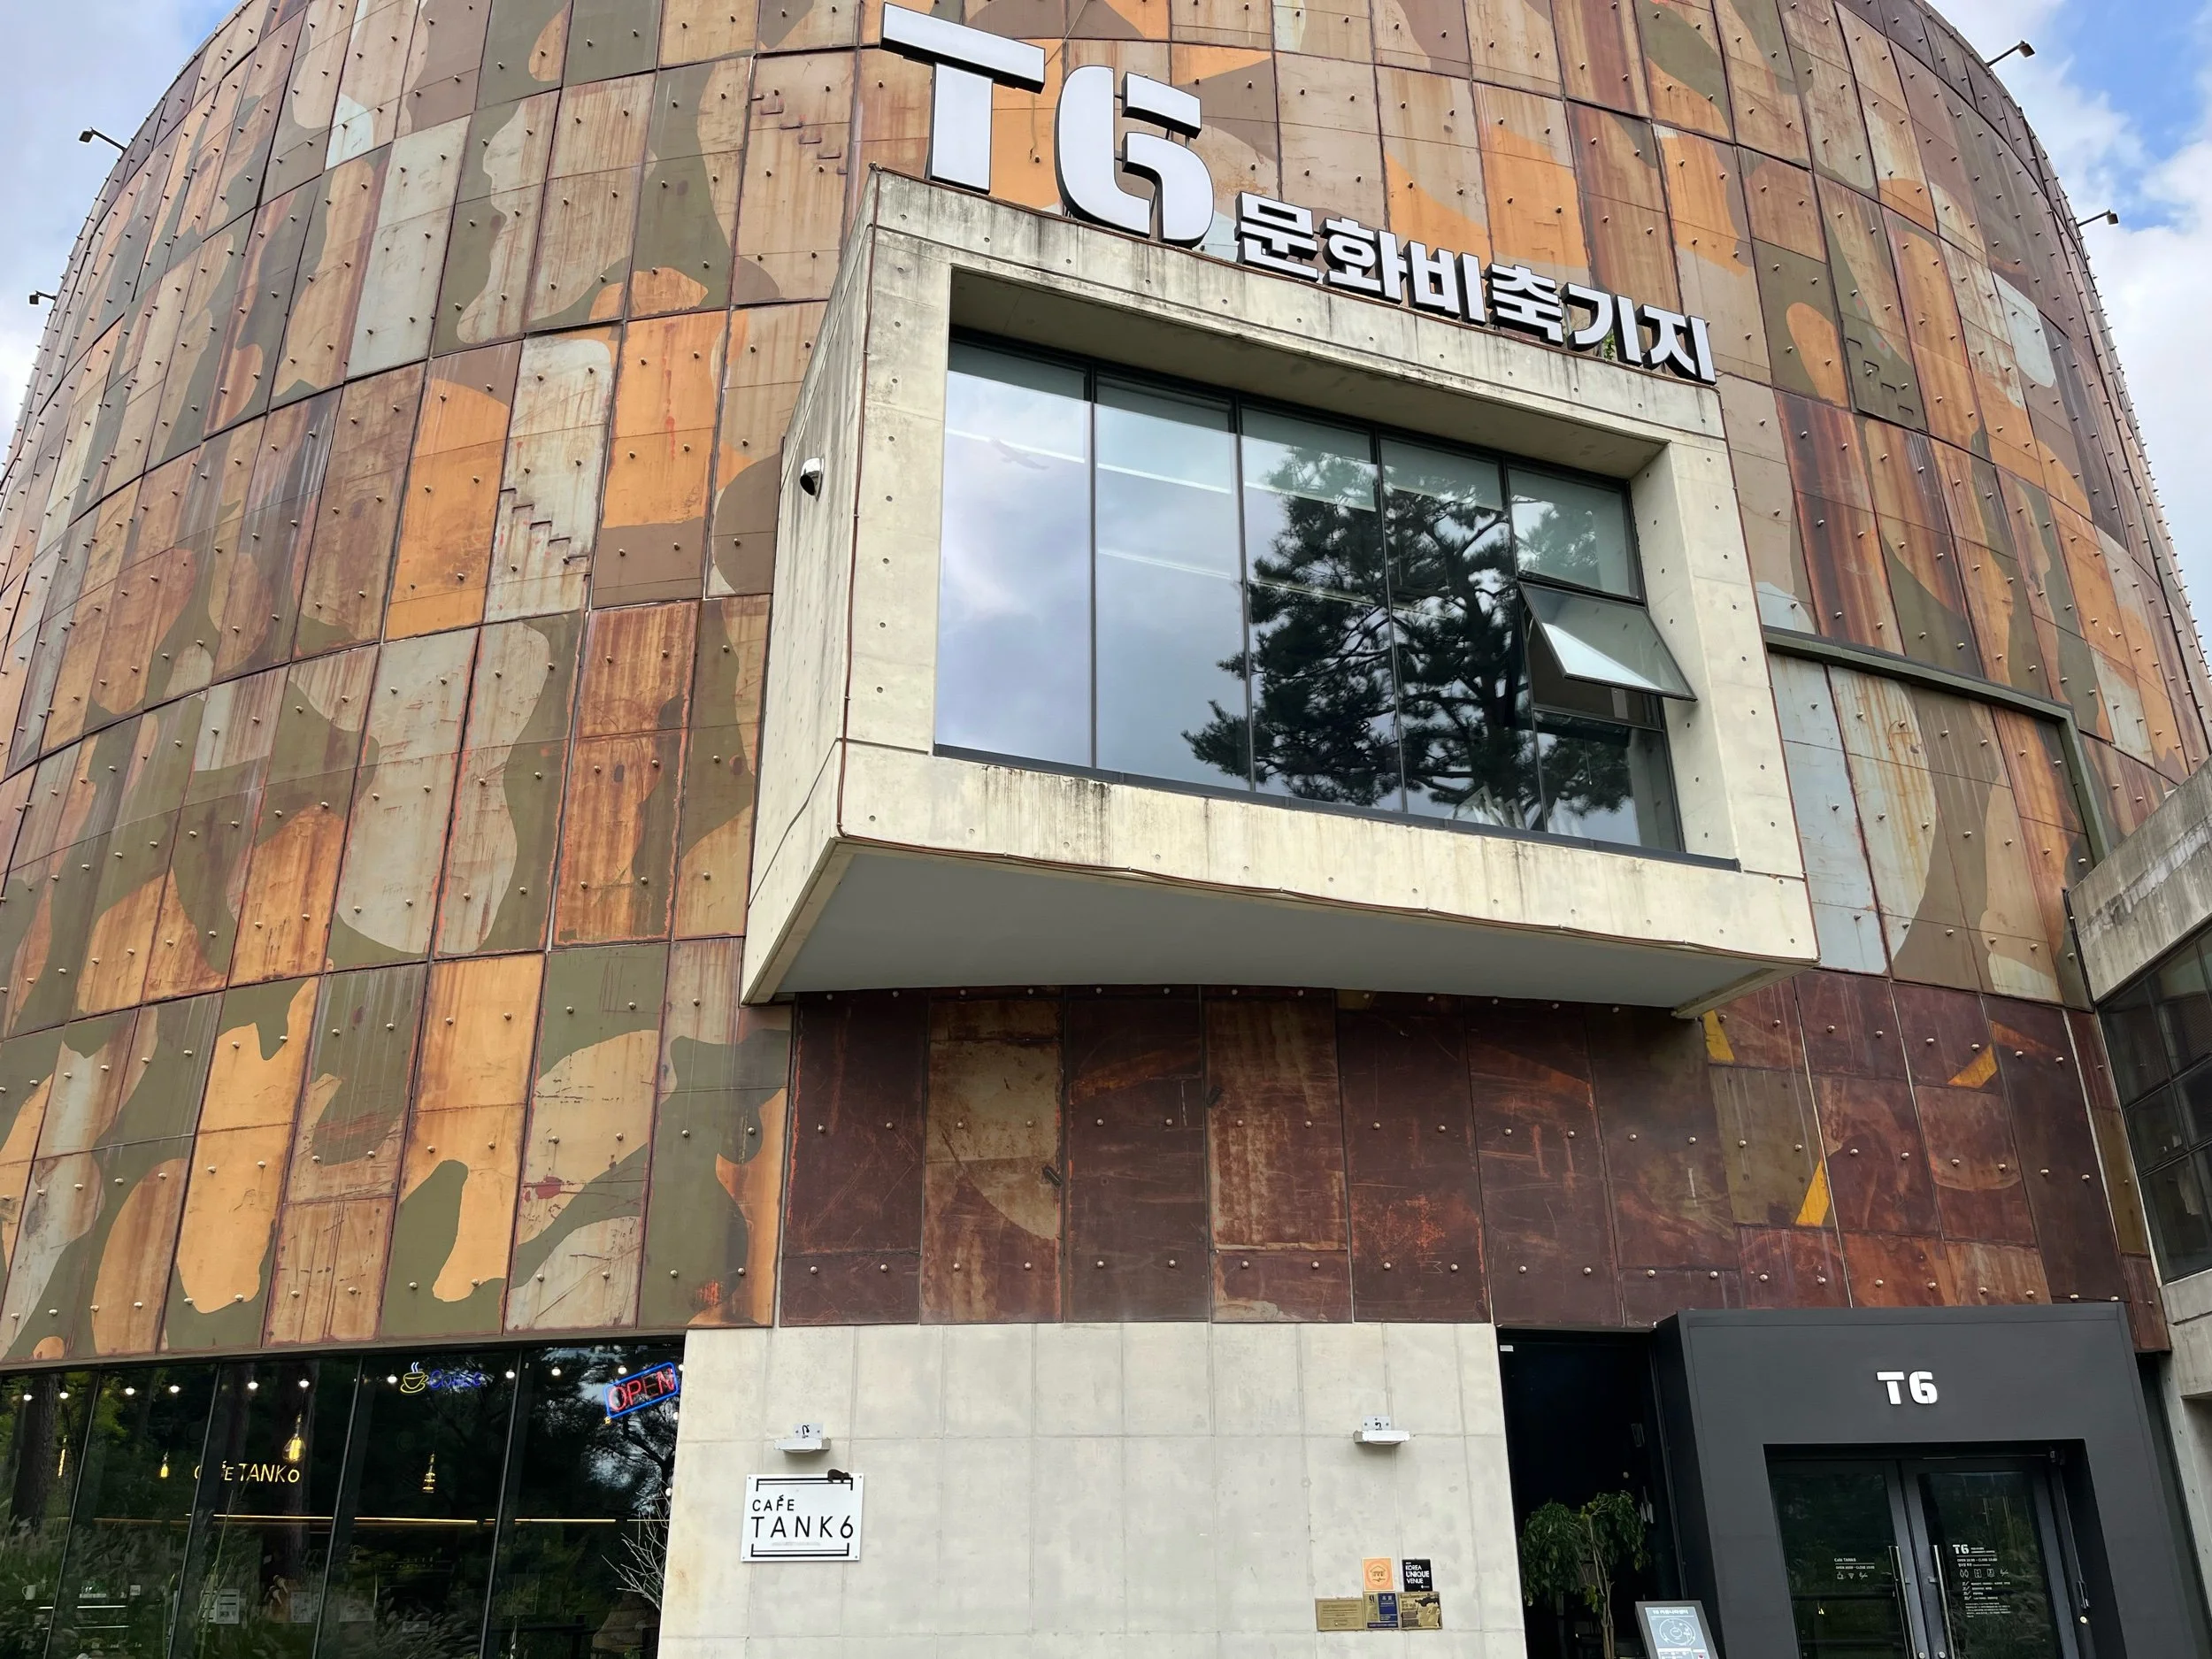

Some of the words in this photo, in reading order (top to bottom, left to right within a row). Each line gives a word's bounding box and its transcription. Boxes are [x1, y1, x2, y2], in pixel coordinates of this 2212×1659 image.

[881, 4, 1214, 248] T6
[1234, 191, 1717, 386] 문화비축기지
[608, 1367, 675, 1412] OPEN
[1876, 1371, 1938, 1405] T6
[750, 1516, 854, 1539] TANK6
[1952, 1544, 1970, 1555] T6
